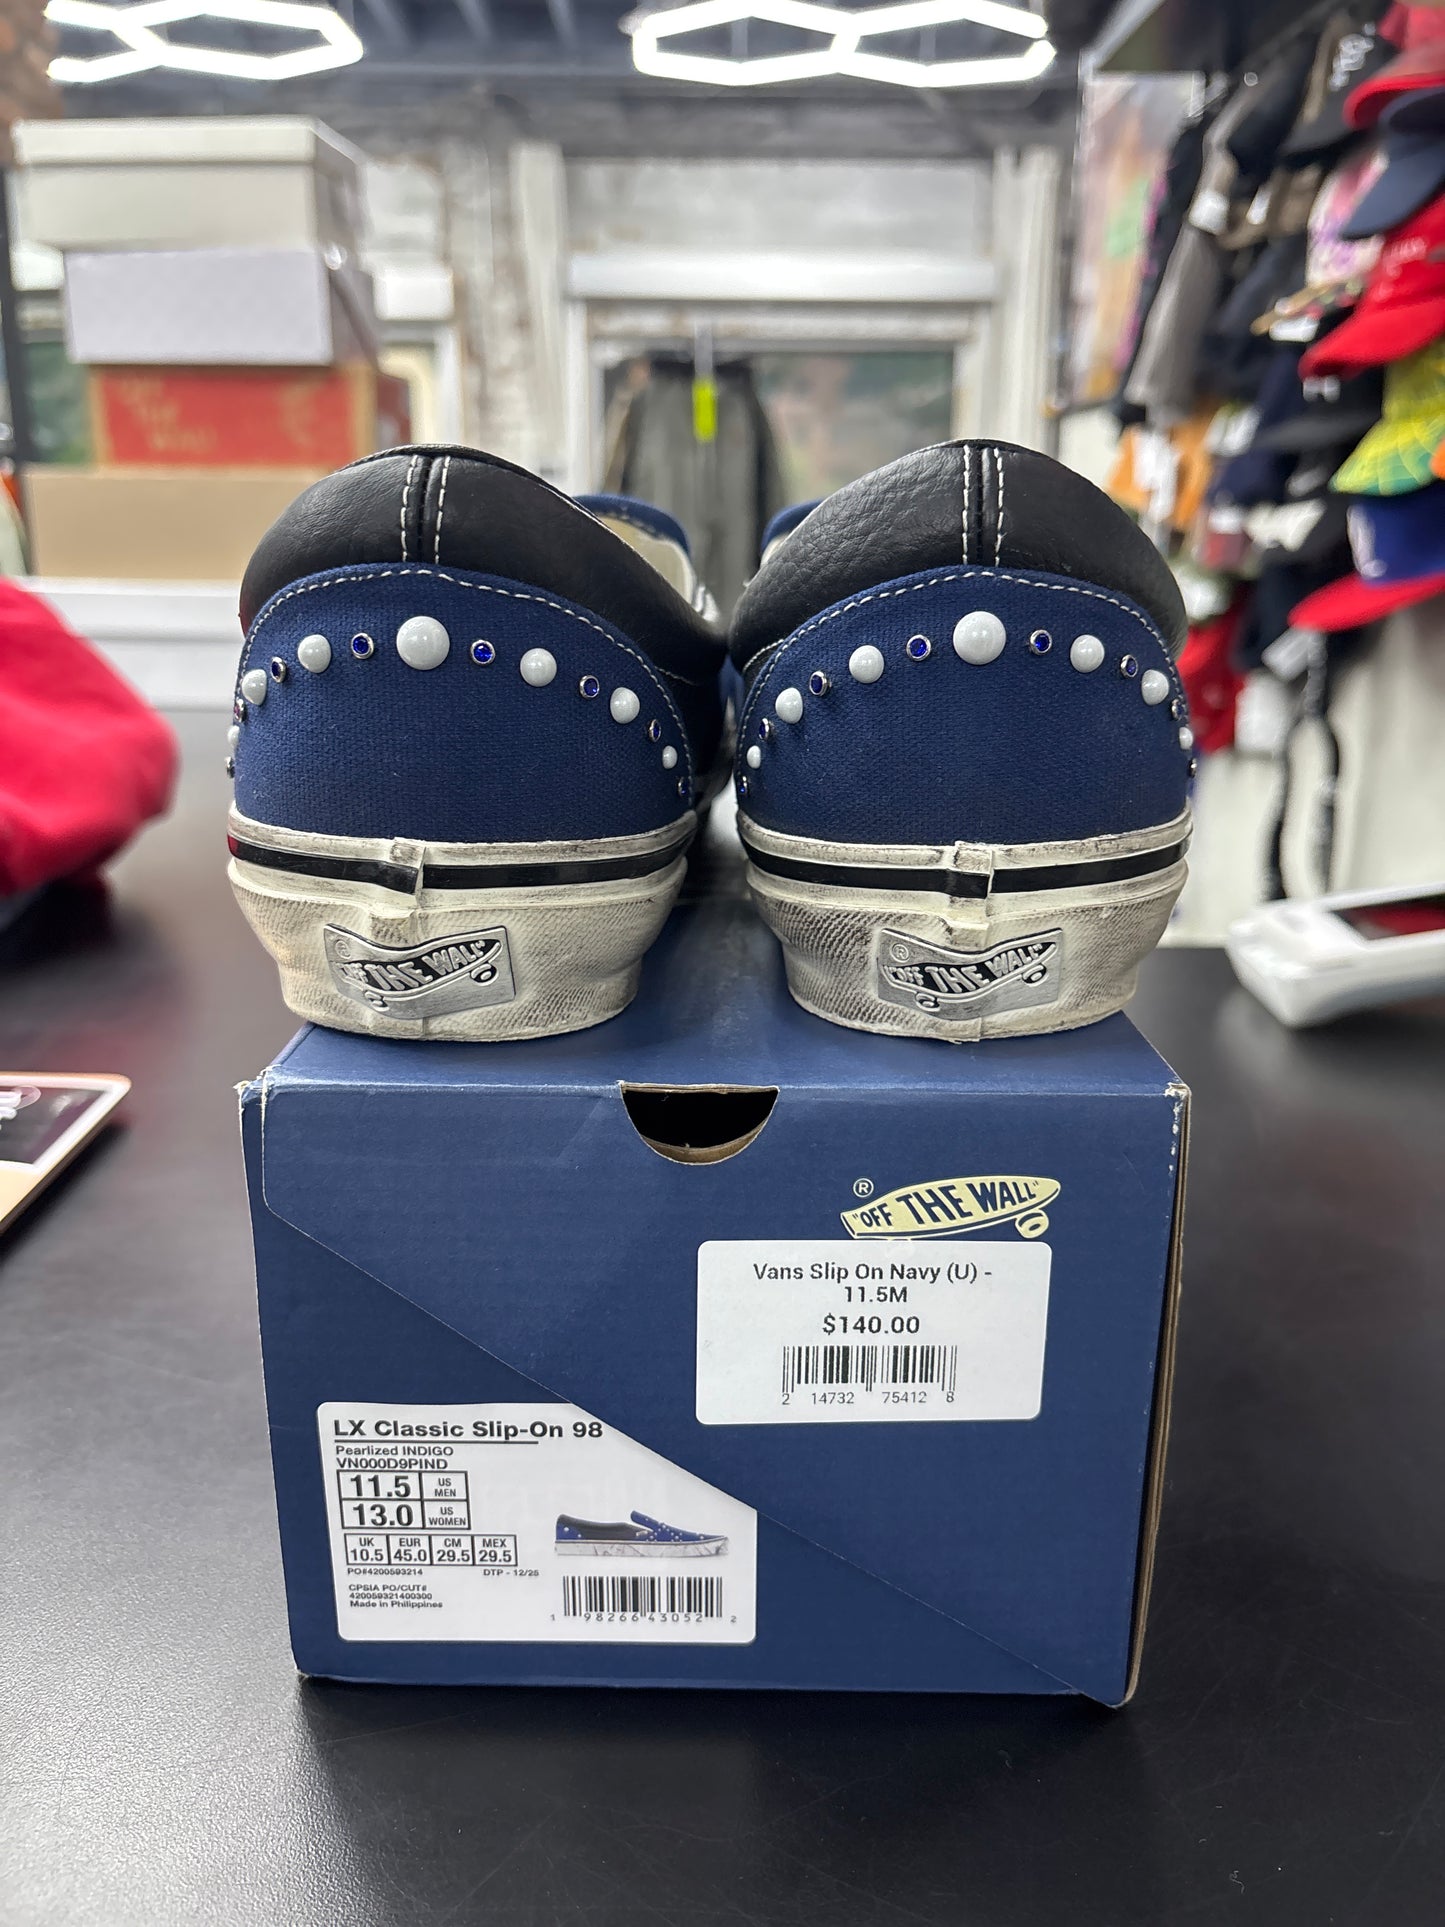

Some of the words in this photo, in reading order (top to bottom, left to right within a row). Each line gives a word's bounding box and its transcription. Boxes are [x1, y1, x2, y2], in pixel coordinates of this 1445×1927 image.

[363, 961, 433, 991] THE
[924, 965, 990, 993] THE
[895, 1185, 973, 1226] THE
[753, 1263, 804, 1280] Vans
[810, 1262, 849, 1284] Slip
[855, 1263, 884, 1280] On
[890, 1263, 941, 1284] Navy
[947, 1262, 978, 1284] (U)
[844, 1286, 908, 1303] 11.5M
[822, 1313, 921, 1336] $140.00
[781, 1393, 791, 1406] 2
[811, 1392, 855, 1405] 14732
[882, 1391, 928, 1404] 75412
[946, 1391, 955, 1404] 8
[334, 1419, 367, 1437] LX
[374, 1420, 465, 1438] Classic
[472, 1420, 564, 1442] Slip-On
[572, 1421, 604, 1438] 98
[336, 1445, 399, 1456] Pearlized
[402, 1446, 454, 1456] INDIGO
[336, 1457, 449, 1470] VN000D9PIND
[350, 1474, 412, 1498] 11.5
[438, 1477, 452, 1487] US
[434, 1488, 457, 1497] MEN
[352, 1503, 414, 1527] 13.0
[440, 1506, 455, 1515] US
[429, 1517, 467, 1526] WOMEN
[359, 1537, 375, 1547] UK
[398, 1537, 422, 1548] EUR
[443, 1538, 462, 1548] CM
[482, 1538, 507, 1548] MEX
[350, 1548, 385, 1562] 10.5
[393, 1549, 428, 1562] 45.0
[436, 1549, 471, 1563] 29.5
[478, 1549, 513, 1563] 29.5
[483, 1568, 504, 1576] DTP
[348, 1584, 380, 1592] CPSIA
[350, 1600, 377, 1608] Made
[379, 1600, 388, 1608] in
[391, 1600, 443, 1609] Philippines
[730, 1615, 738, 1624] 2
